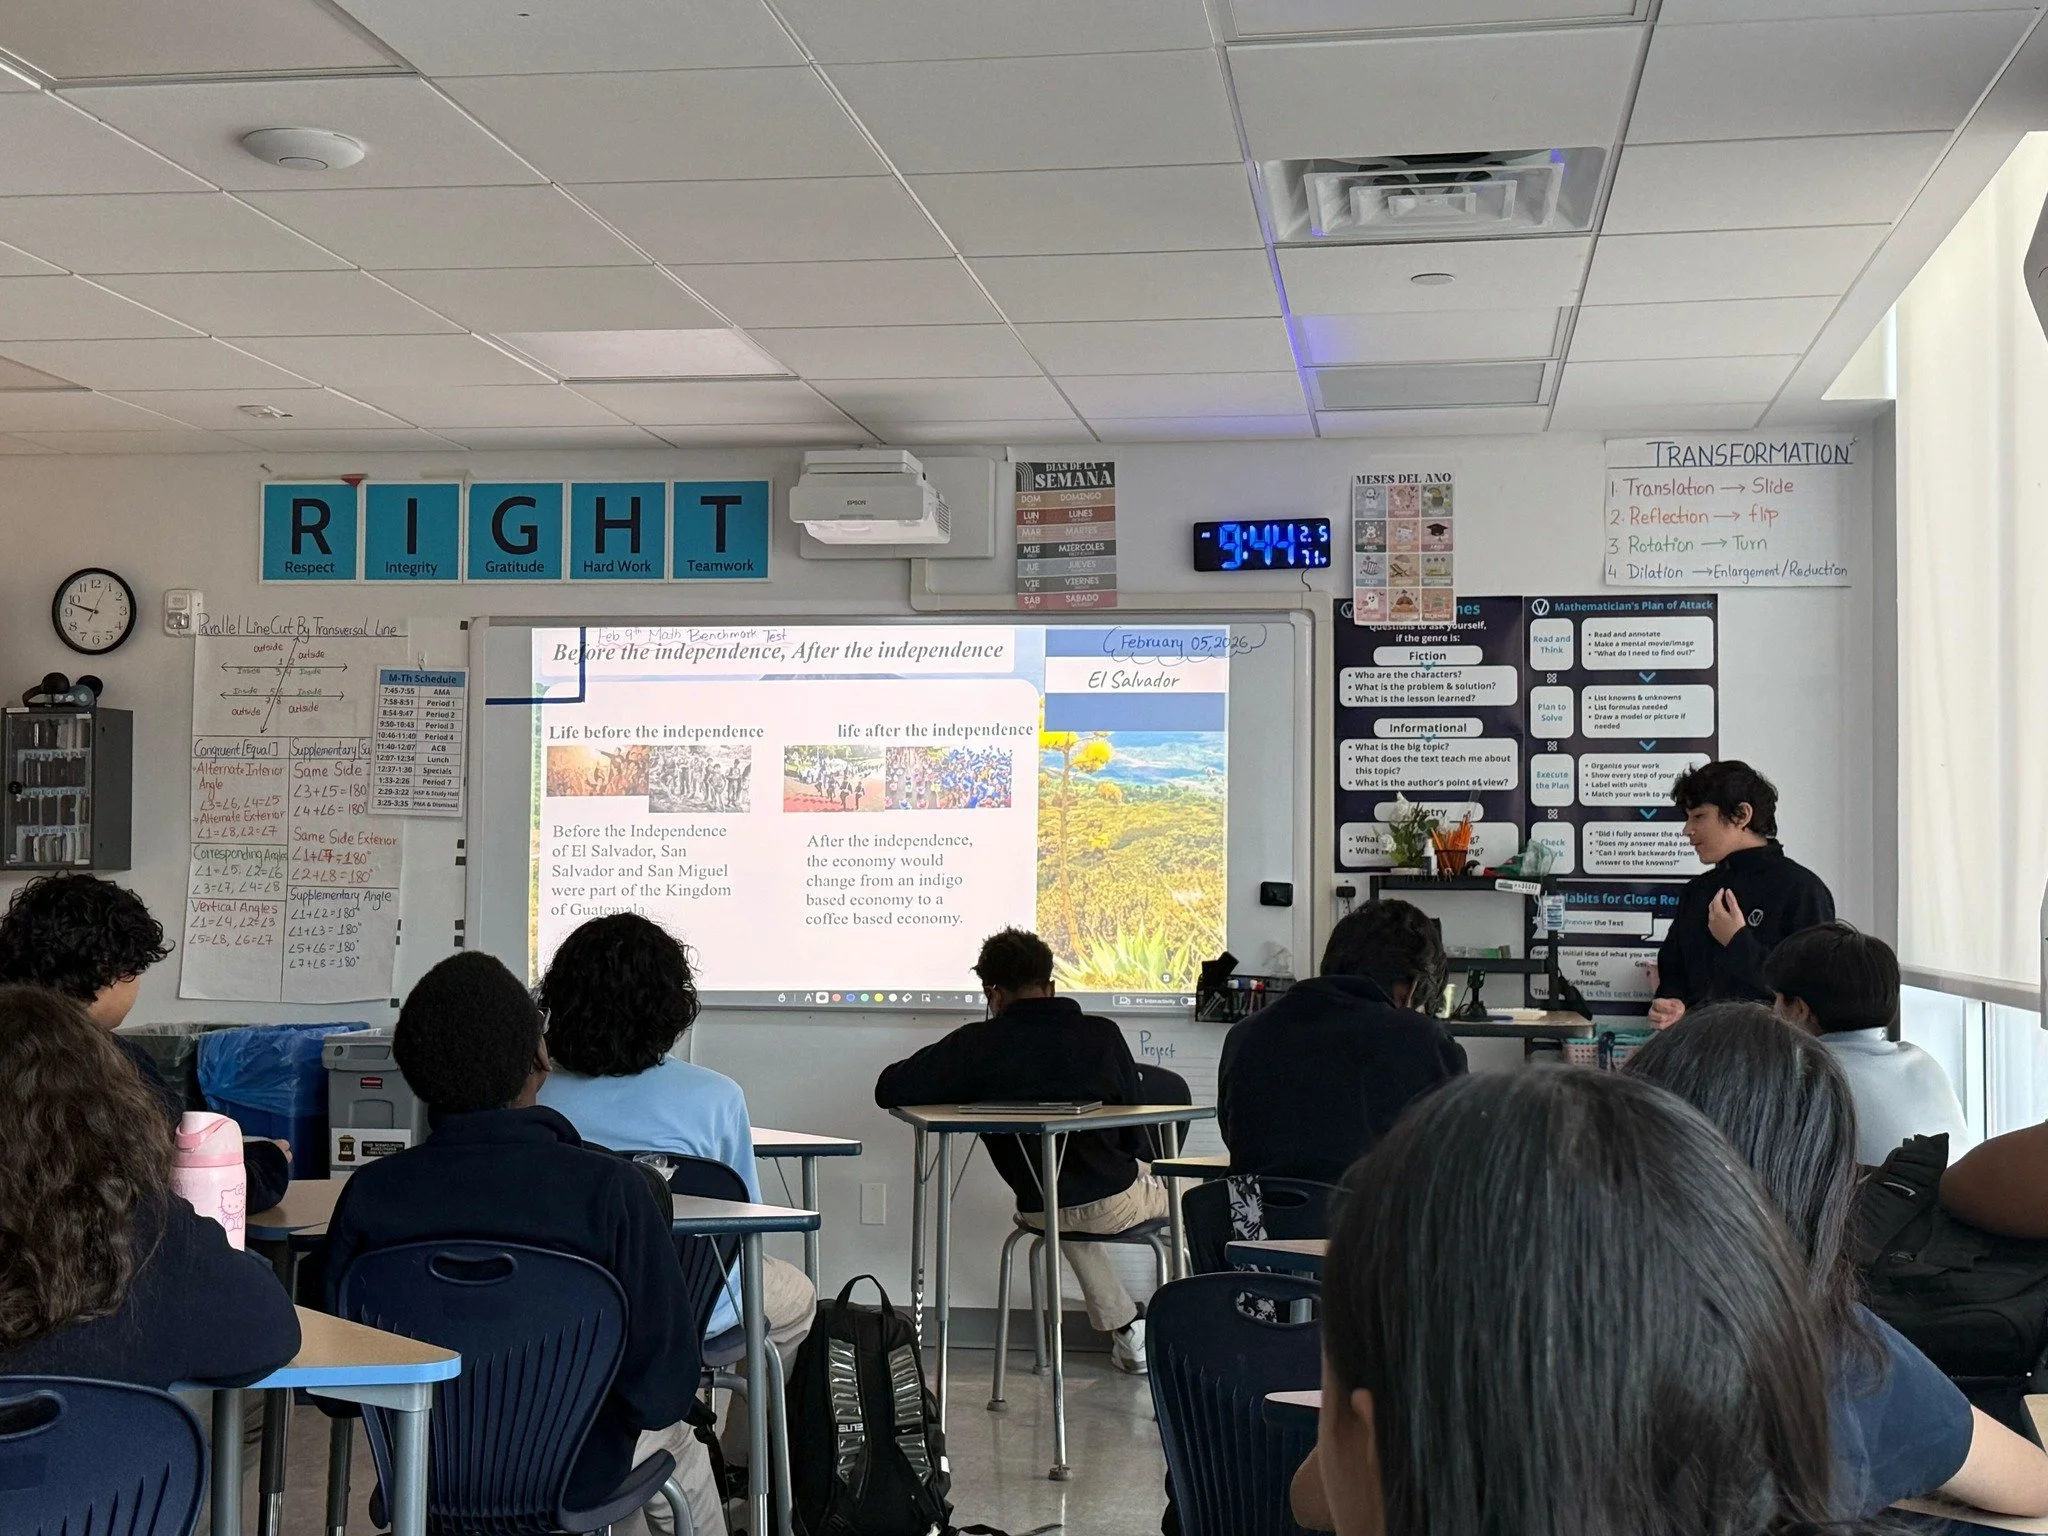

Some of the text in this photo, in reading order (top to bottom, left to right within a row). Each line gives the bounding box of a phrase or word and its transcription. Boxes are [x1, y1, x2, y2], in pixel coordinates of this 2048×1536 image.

[1646, 442, 1849, 467] TRANSFORMATION
[1035, 471, 1112, 489] SEMANA
[1356, 474, 1395, 484] MESES
[1399, 474, 1421, 484] DEL
[1623, 477, 1714, 496] Translation
[1752, 477, 1794, 494] Slide
[1021, 492, 1101, 503] DOM DOMINGO
[1024, 509, 1093, 520] LUN LUNES
[1630, 506, 1708, 525] Reflection
[1749, 504, 1778, 528] flip
[1220, 524, 1295, 568] 9:44
[1629, 535, 1694, 553] Rotation
[1733, 535, 1767, 550] Turn
[285, 561, 335, 576] Respect
[385, 559, 438, 576] Integrity
[485, 559, 544, 574] Gratitude
[583, 559, 652, 574] Hard Work
[687, 558, 754, 573] Teamwork
[1608, 559, 1848, 584] 4 Dilation Enlargement/Reduction
[1025, 577, 1099, 588] VIE VIERNES
[1555, 601, 1713, 611] Mathematician's Plan of Attack
[198, 615, 240, 635] Parallel
[297, 616, 310, 644] By
[313, 617, 368, 636] Transversal
[375, 619, 397, 636] Line
[598, 629, 620, 643] Feb
[649, 629, 681, 641] Math
[689, 629, 757, 642] Benchmark
[763, 629, 787, 643] Test
[1121, 634, 1183, 659] February
[1396, 634, 1460, 644] if the genre is:
[553, 641, 1004, 665] Before the independence, After the independence
[1409, 651, 1446, 661] Fiction
[389, 674, 456, 684] M-Th Schedule
[1088, 670, 1180, 689] El Salvador
[1541, 714, 1563, 722] Solve
[549, 725, 764, 741] Life before the independence
[838, 723, 1033, 739] life after the independence
[1390, 724, 1466, 732] Informational
[196, 763, 284, 776] Alternate Interior
[423, 767, 451, 775] Specials
[199, 777, 223, 800] Angle
[294, 829, 399, 846] Same Side Exterior
[553, 824, 727, 840] Before the Independence
[807, 834, 973, 850] After the independence,
[552, 844, 687, 859] of El Salvador, San
[807, 854, 943, 869] the economy would
[552, 864, 728, 880] Salvador and San Miguel
[806, 873, 963, 889] change from an indigo
[551, 884, 731, 899] were part of the Kingdom
[1603, 893, 1657, 905] for Close
[290, 888, 392, 911] Supplementary Angle
[806, 894, 943, 908] based economy to a
[192, 901, 277, 919] Vertical Angles
[551, 903, 568, 916] of
[806, 912, 963, 926] coffee based economy.
[1140, 1030, 1176, 1066] Project
